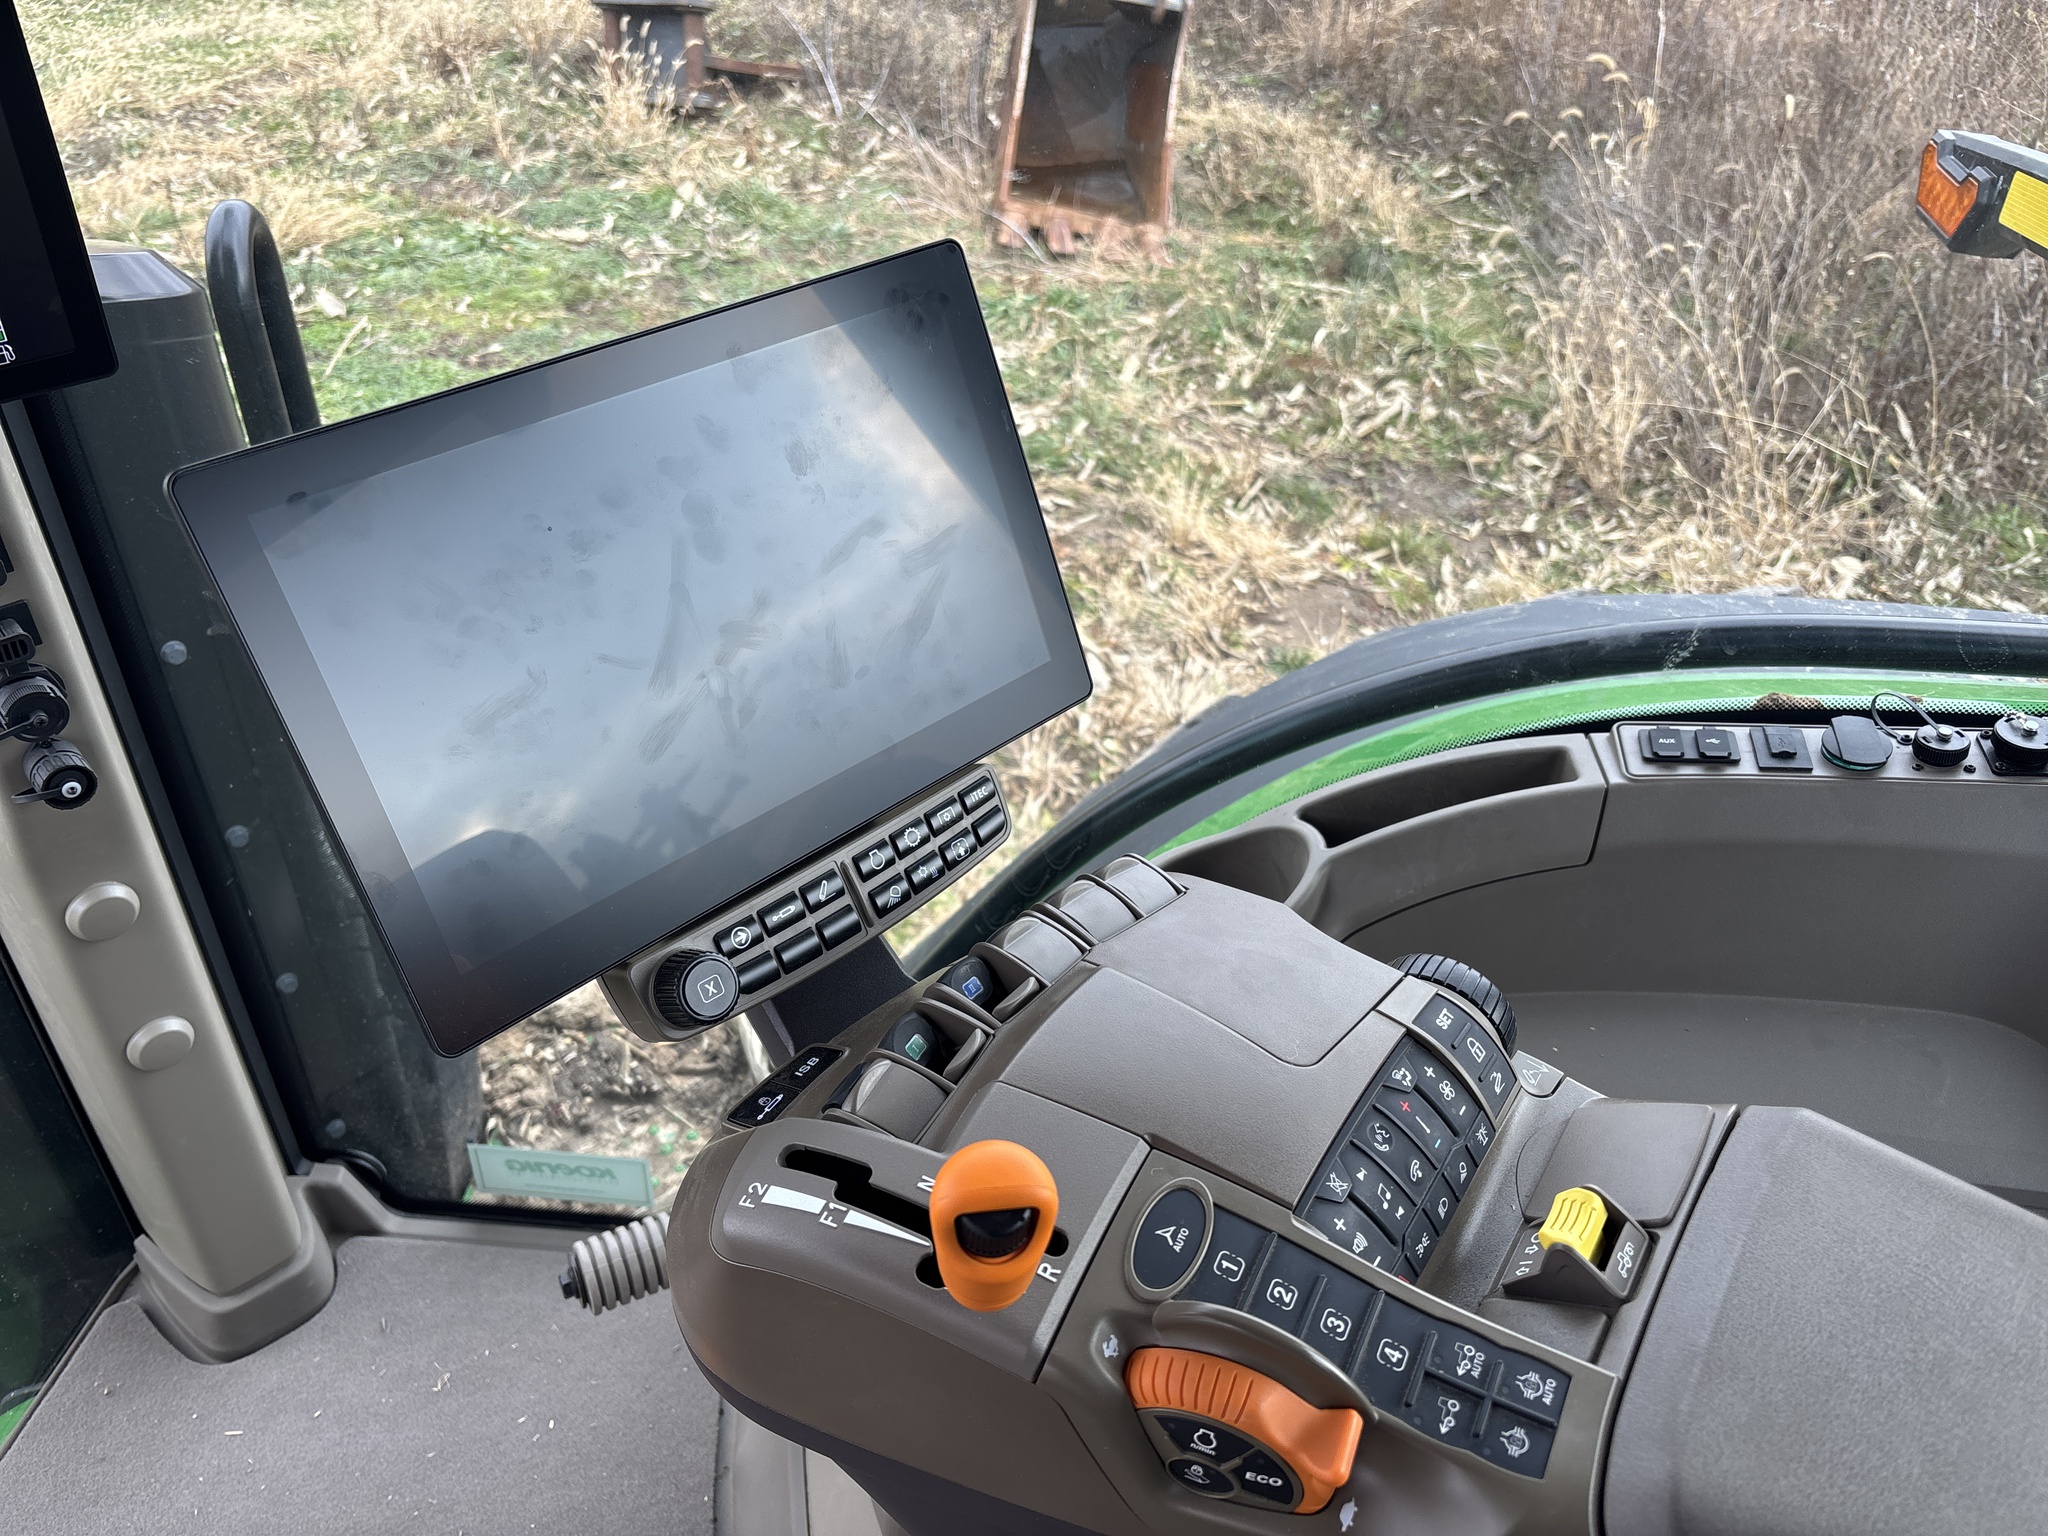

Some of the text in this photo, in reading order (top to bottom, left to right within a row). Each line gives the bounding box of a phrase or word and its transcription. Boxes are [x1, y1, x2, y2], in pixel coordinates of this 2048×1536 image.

[1658, 737, 1676, 745] AUX
[704, 980, 718, 997] X
[1435, 1007, 1455, 1030] SET
[794, 1056, 820, 1077] ISB
[916, 1174, 936, 1193] N
[738, 1182, 769, 1209] F2
[818, 1202, 848, 1228] F1
[1172, 1227, 1190, 1253] AUTO
[1036, 1262, 1062, 1283] R
[1220, 1259, 1239, 1272] 1
[1273, 1286, 1293, 1304] 2
[1327, 1316, 1346, 1333] 3
[1383, 1346, 1404, 1364] 4
[1470, 1352, 1486, 1380] AUTO
[1541, 1378, 1558, 1406] AUTO
[1245, 1471, 1283, 1487] ECO
